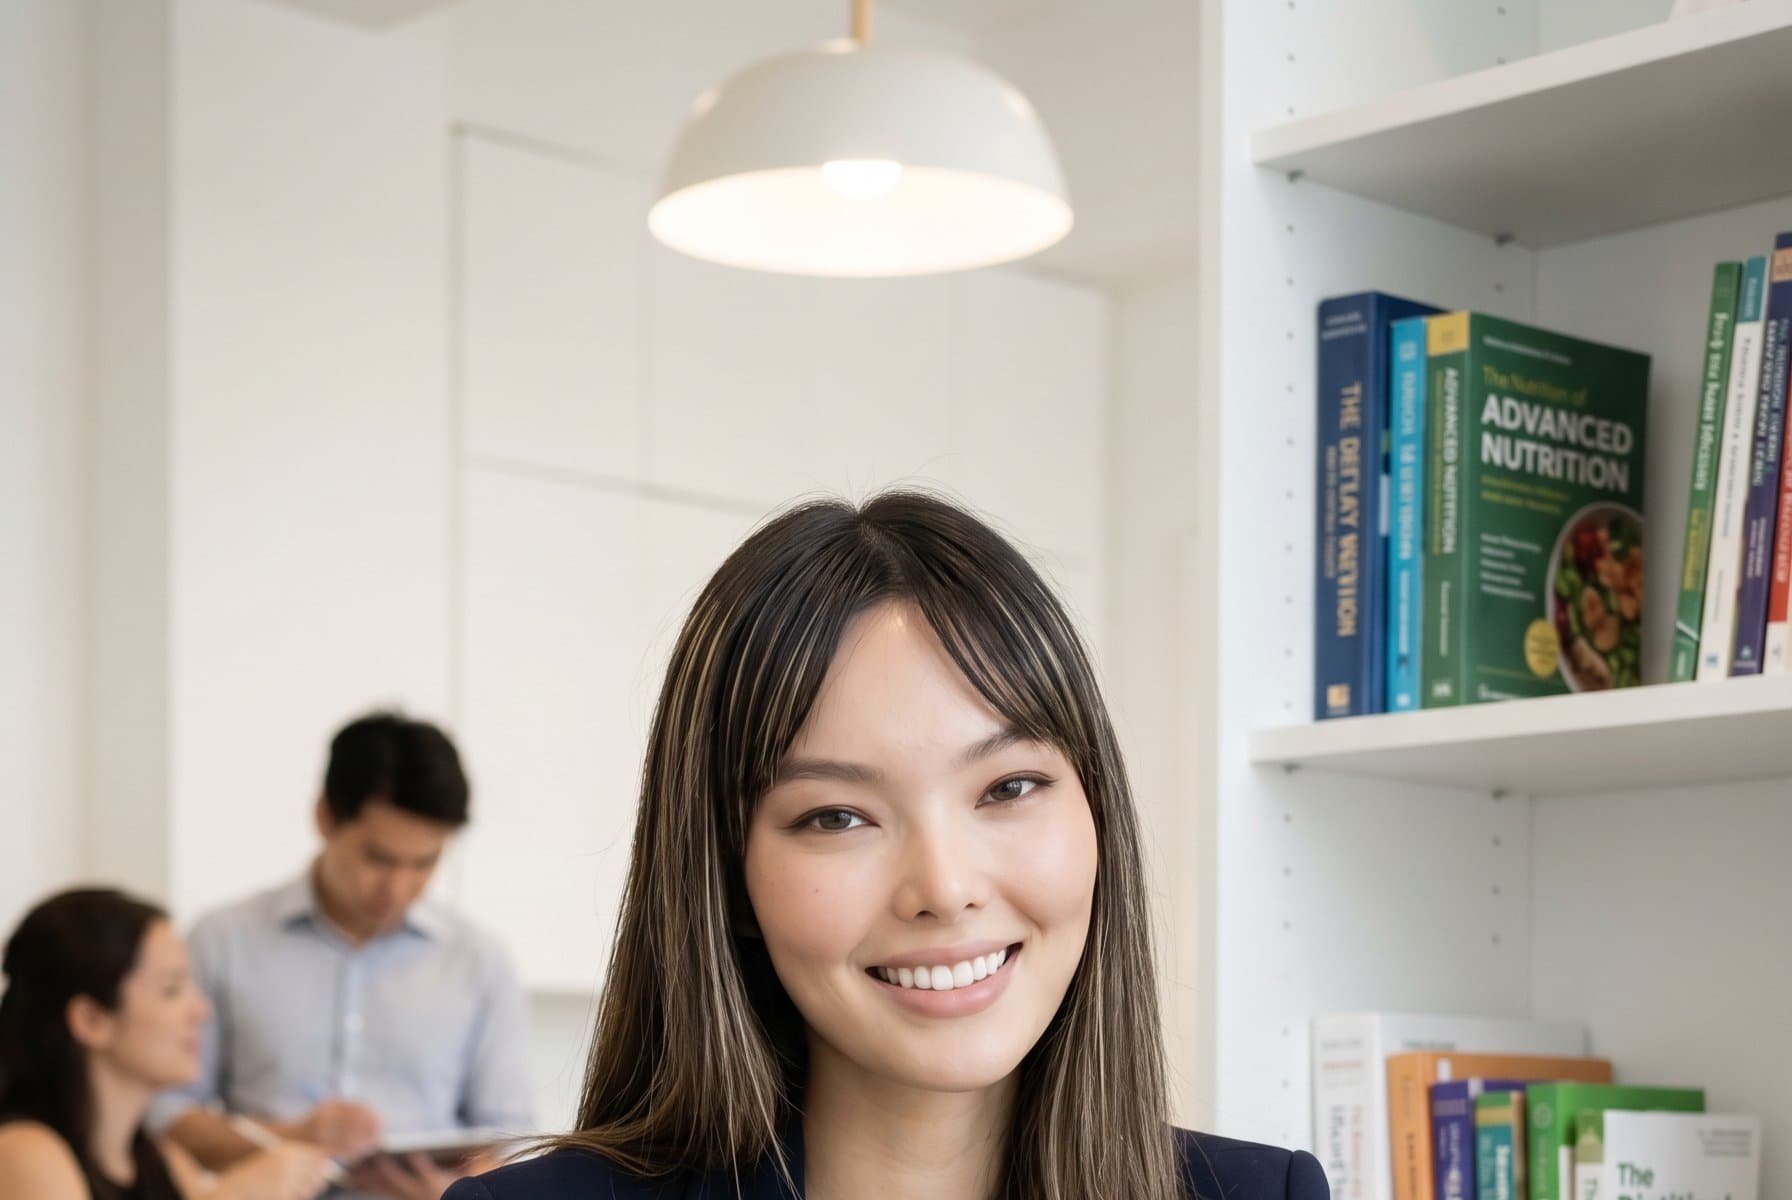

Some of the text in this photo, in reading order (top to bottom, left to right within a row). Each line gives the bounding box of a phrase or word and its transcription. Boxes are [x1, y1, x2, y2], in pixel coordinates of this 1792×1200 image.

[1481, 394, 1633, 454] ADVANCED
[1481, 431, 1629, 492] NUTRITION
[1617, 1162, 1654, 1188] The
